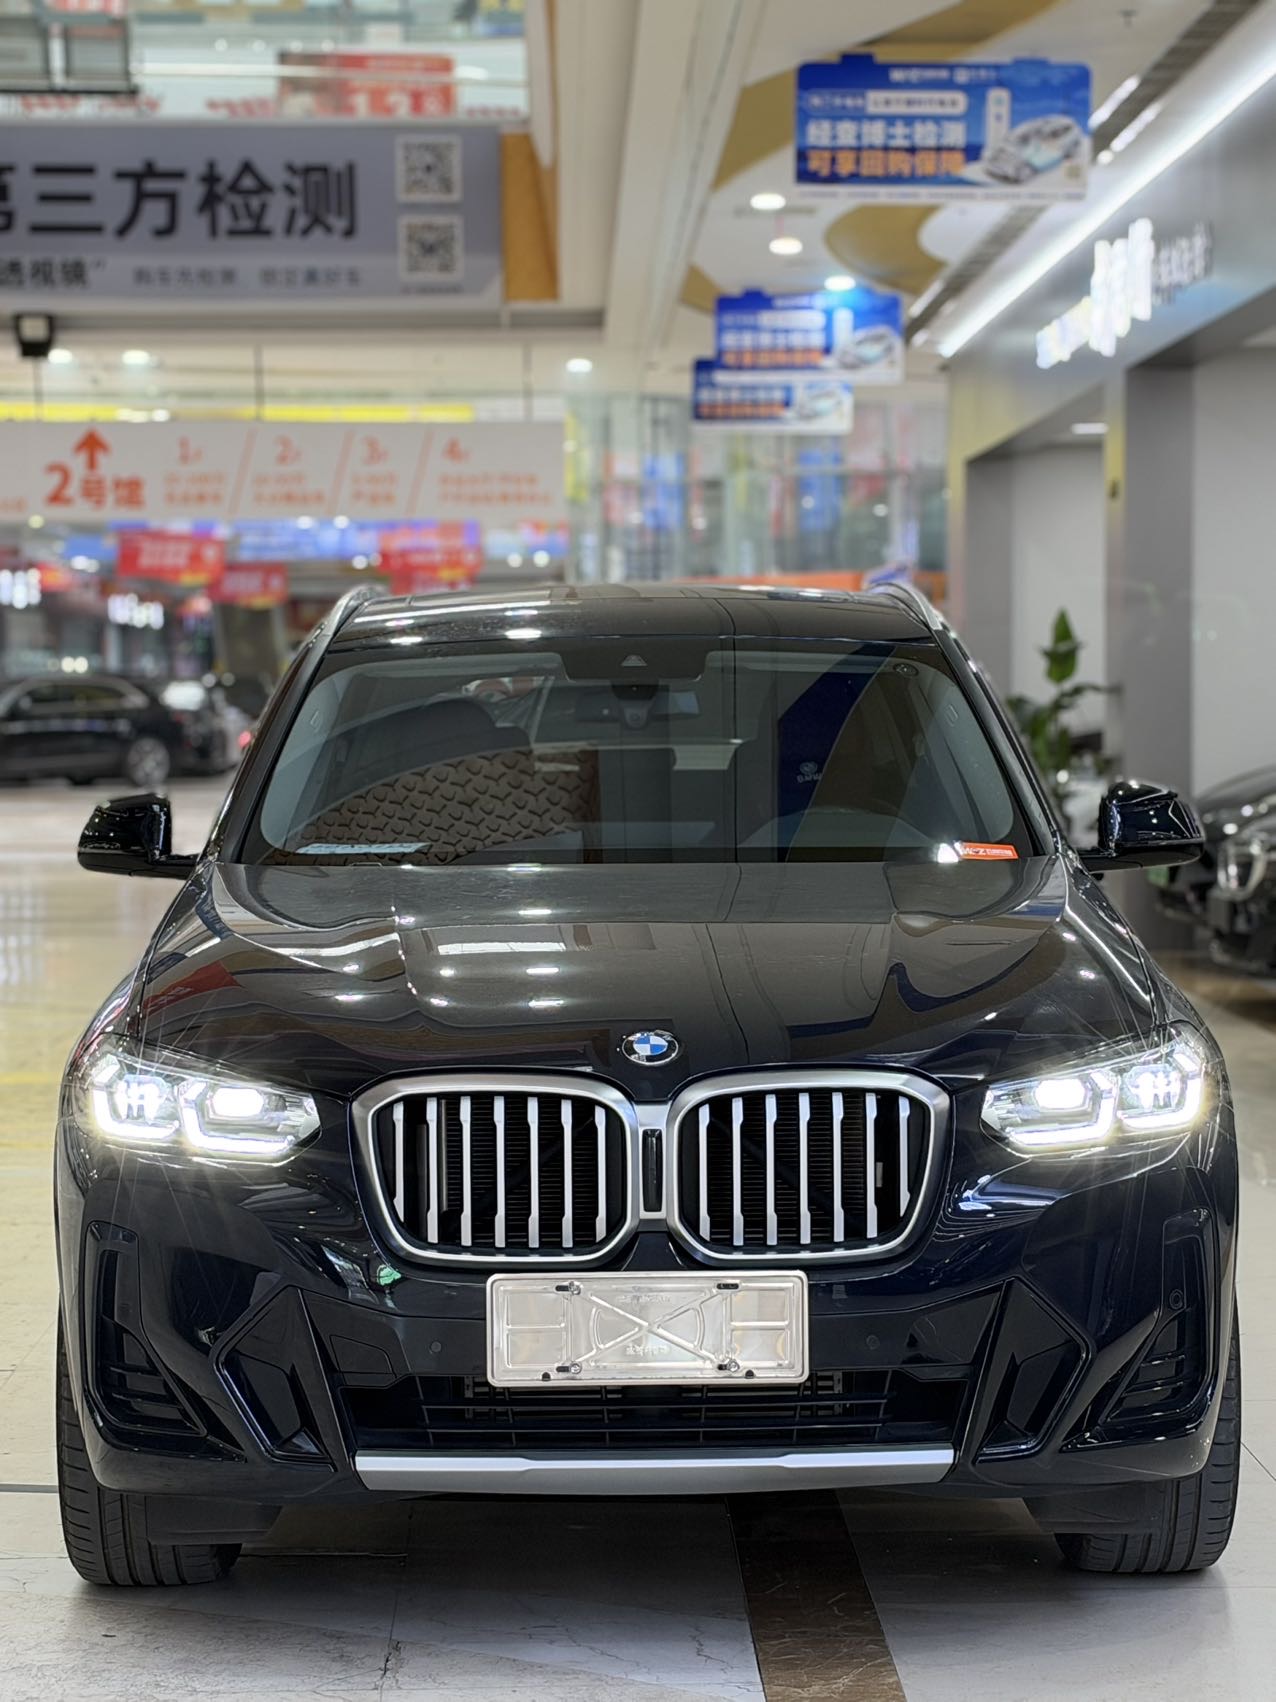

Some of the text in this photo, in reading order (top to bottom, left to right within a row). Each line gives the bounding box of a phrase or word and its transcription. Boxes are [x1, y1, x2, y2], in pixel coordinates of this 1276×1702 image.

[0, 159, 358, 240] 三方检测
[45, 462, 145, 509] 2号馆
